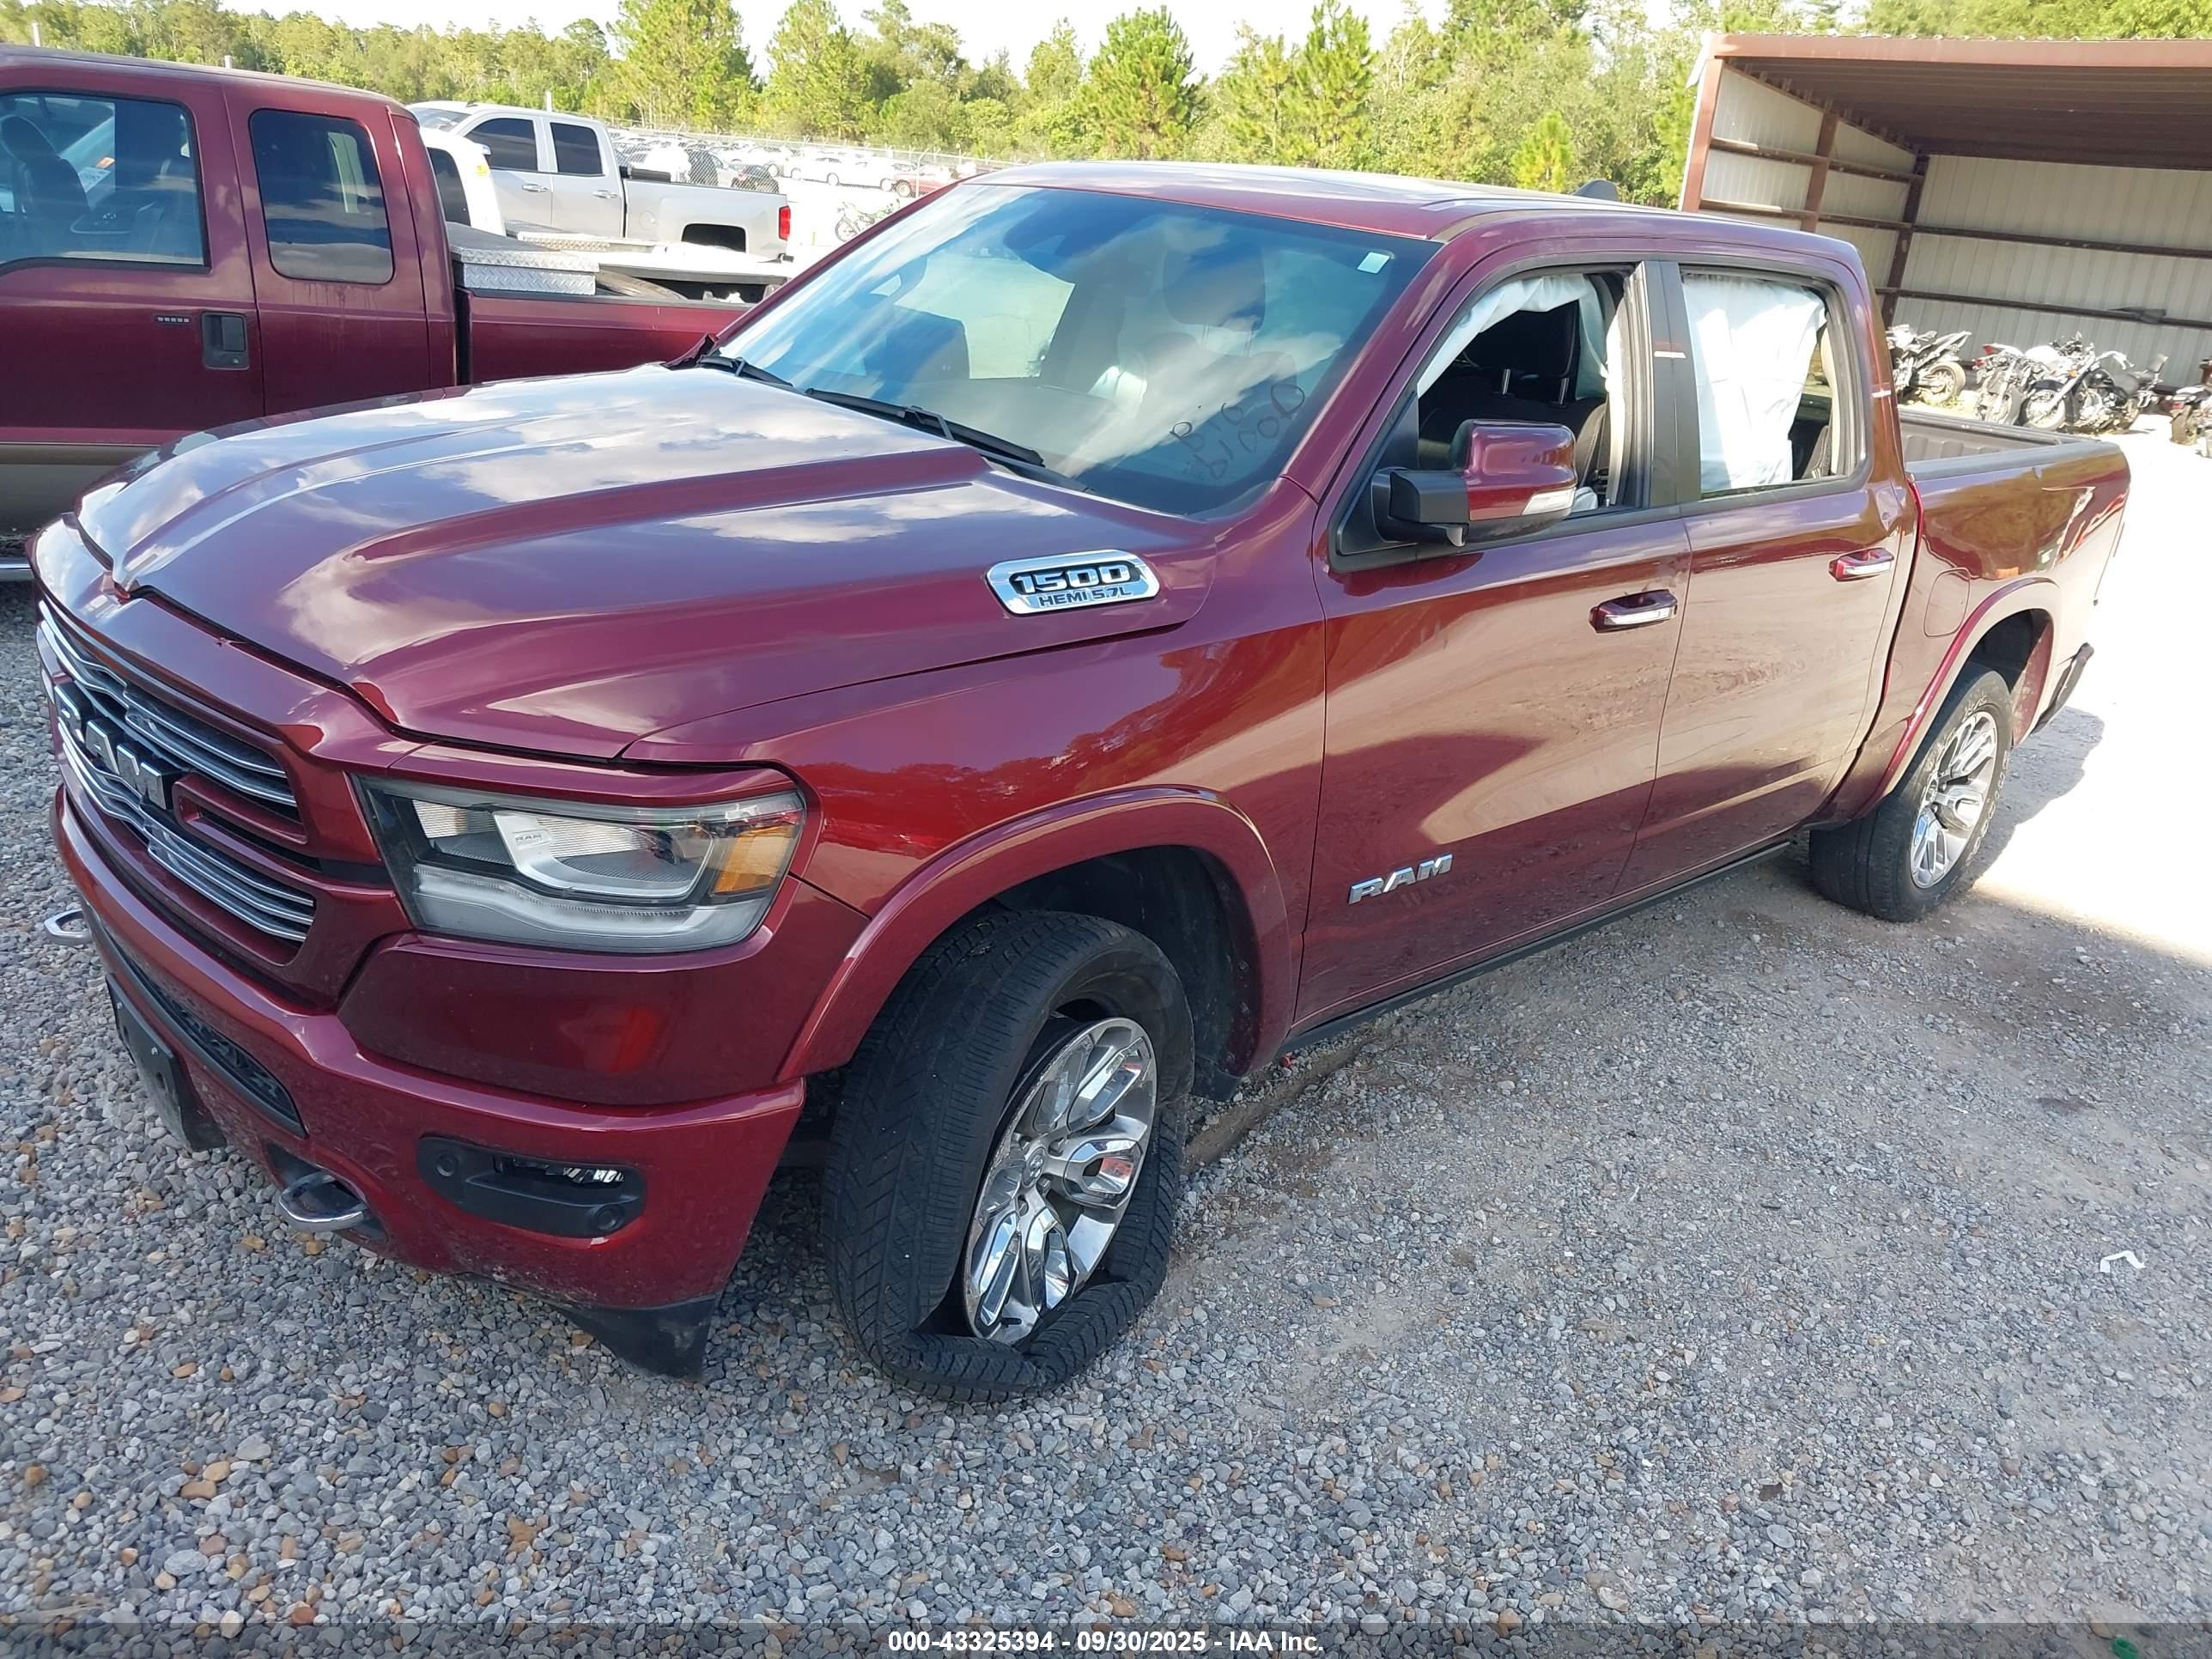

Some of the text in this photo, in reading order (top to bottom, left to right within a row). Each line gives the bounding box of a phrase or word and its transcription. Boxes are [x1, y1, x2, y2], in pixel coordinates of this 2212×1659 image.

[1015, 563, 1132, 595] 1500
[1038, 586, 1133, 607] HEMI 5.7L
[1347, 854, 1454, 904] RAM
